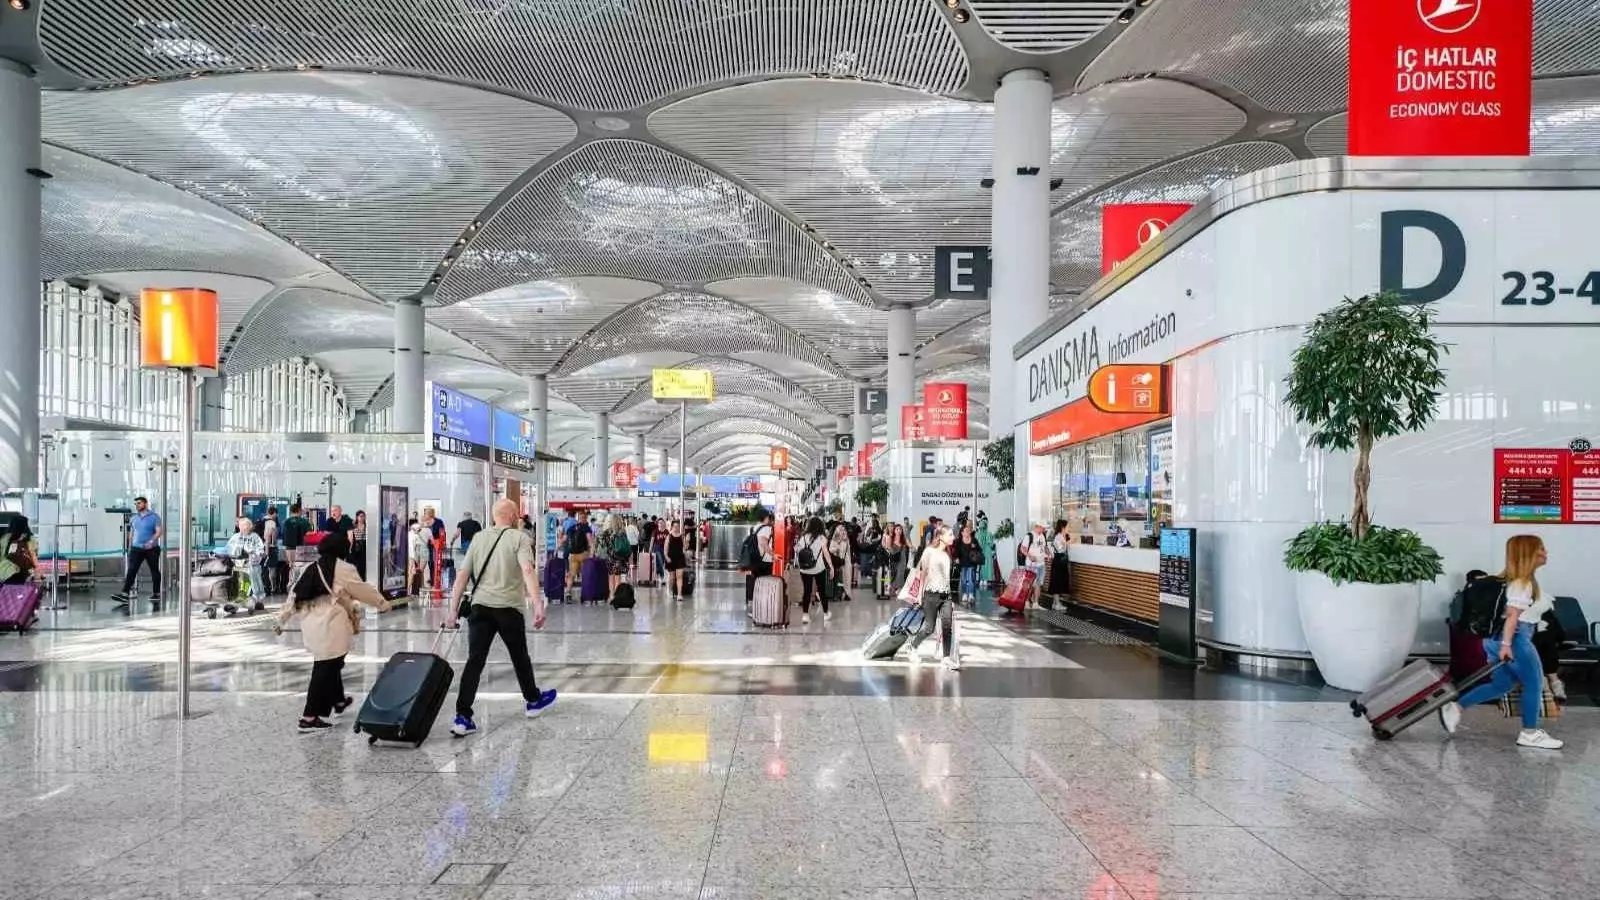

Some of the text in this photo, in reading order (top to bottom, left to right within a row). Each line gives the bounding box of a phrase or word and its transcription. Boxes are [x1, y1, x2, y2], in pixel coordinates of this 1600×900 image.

[1397, 45, 1497, 72] İÇ HATLAR
[1397, 70, 1496, 92] DOMESTIC
[1389, 102, 1501, 119] ECONOMY CLASS
[1380, 209, 1467, 305] D
[950, 252, 975, 292] E
[1029, 312, 1176, 403] DANIŞMA Information
[866, 391, 879, 411] F
[838, 436, 851, 450] G
[825, 456, 834, 469] H
[920, 452, 974, 474] E 22-43
[1508, 467, 1526, 475] 444
